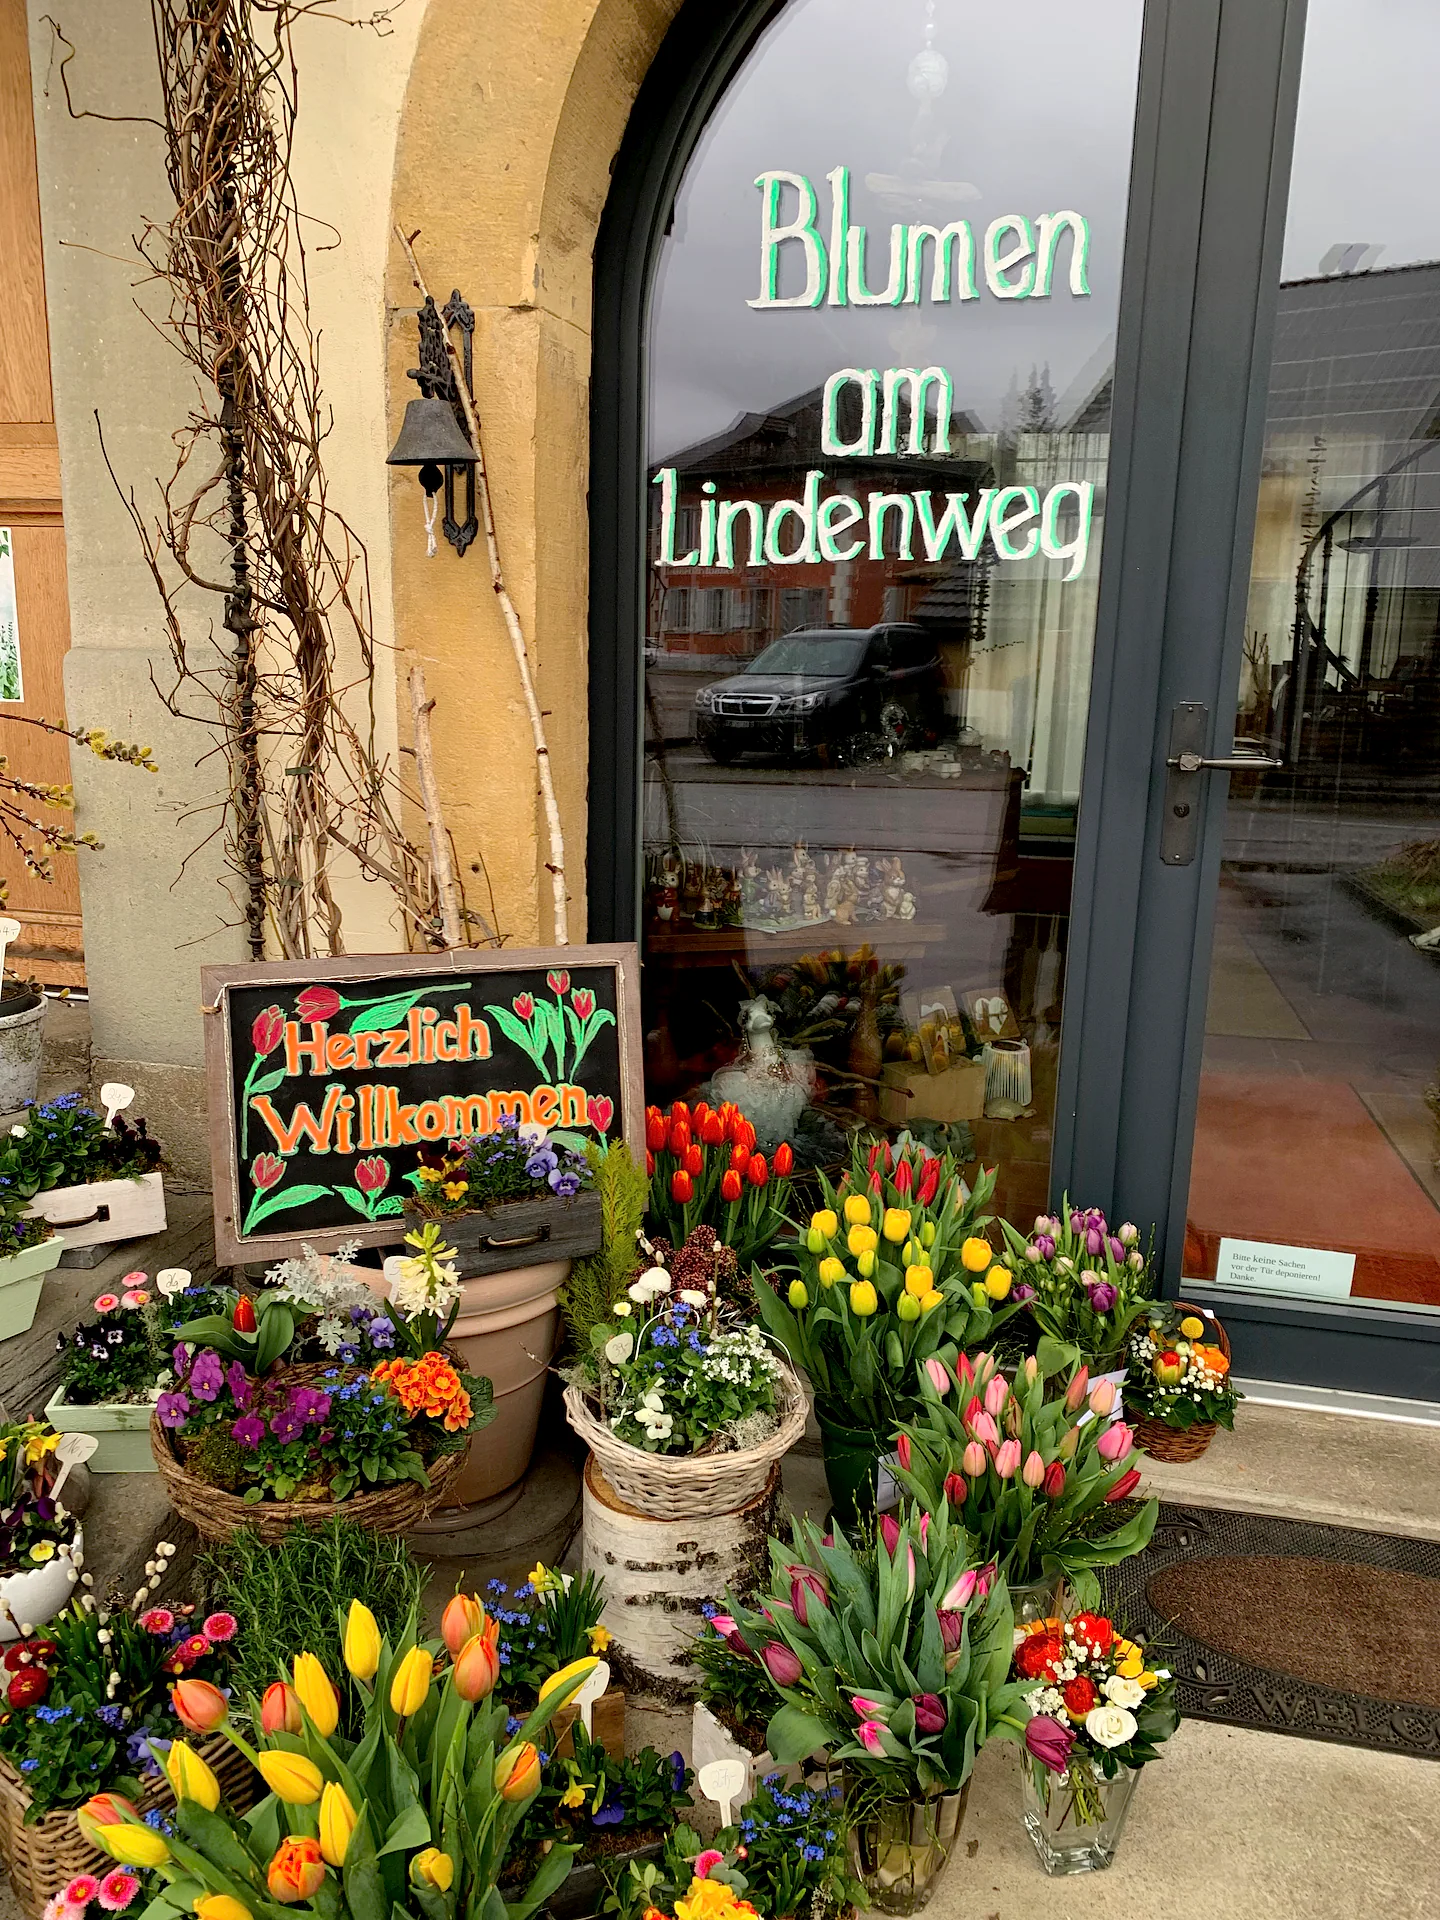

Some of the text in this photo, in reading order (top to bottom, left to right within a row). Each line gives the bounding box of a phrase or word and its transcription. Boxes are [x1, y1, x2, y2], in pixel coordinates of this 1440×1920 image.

[745, 165, 1092, 309] Blumen
[821, 366, 953, 457] am
[652, 467, 1095, 582] Lindenweg
[284, 1003, 492, 1076] Herzlich
[250, 1082, 592, 1154] Willkommen
[1230, 1272, 1256, 1282] Danke.
[1231, 1263, 1321, 1282] vor der Tür deponieren!
[1232, 1252, 1306, 1270] Bitte keine Sachen
